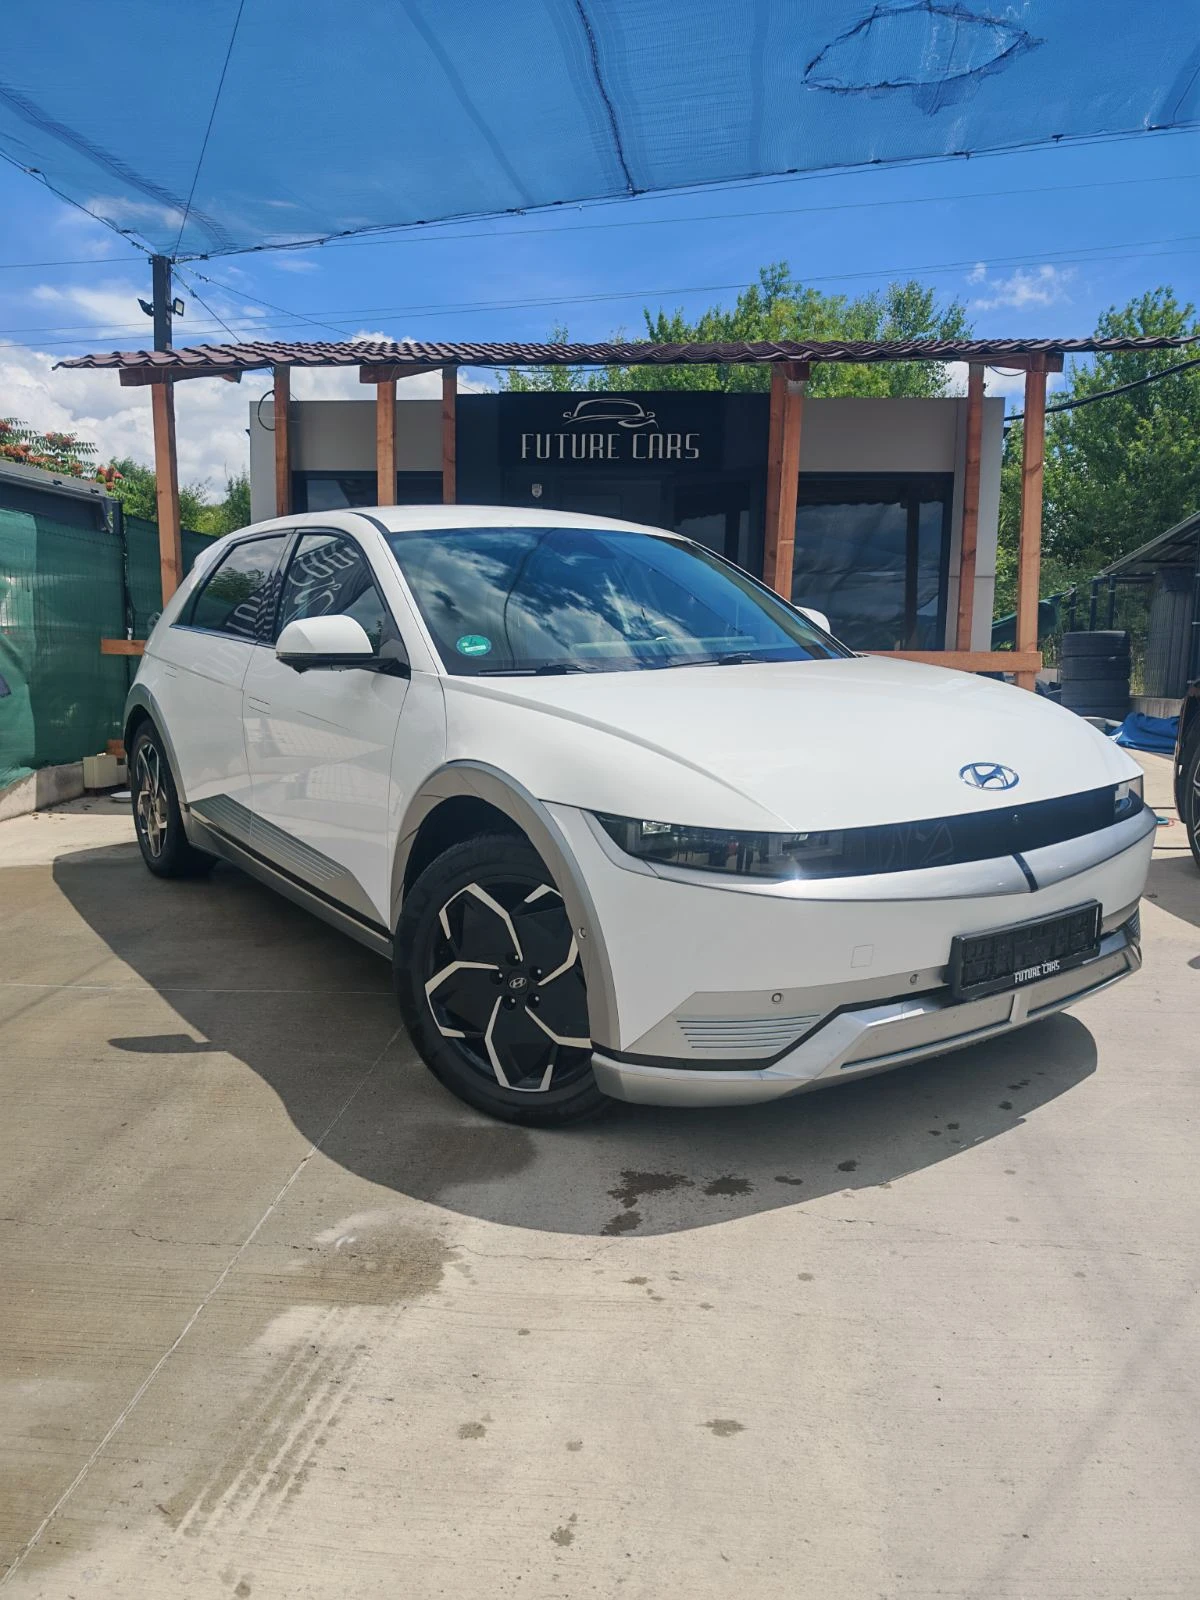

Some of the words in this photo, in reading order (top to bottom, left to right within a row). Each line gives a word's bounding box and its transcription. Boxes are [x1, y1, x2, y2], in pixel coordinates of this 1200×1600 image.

[521, 433, 620, 459] FUTURE
[632, 433, 700, 459] CARS
[1014, 966, 1041, 984] FUTURE
[1041, 960, 1060, 974] CARS
